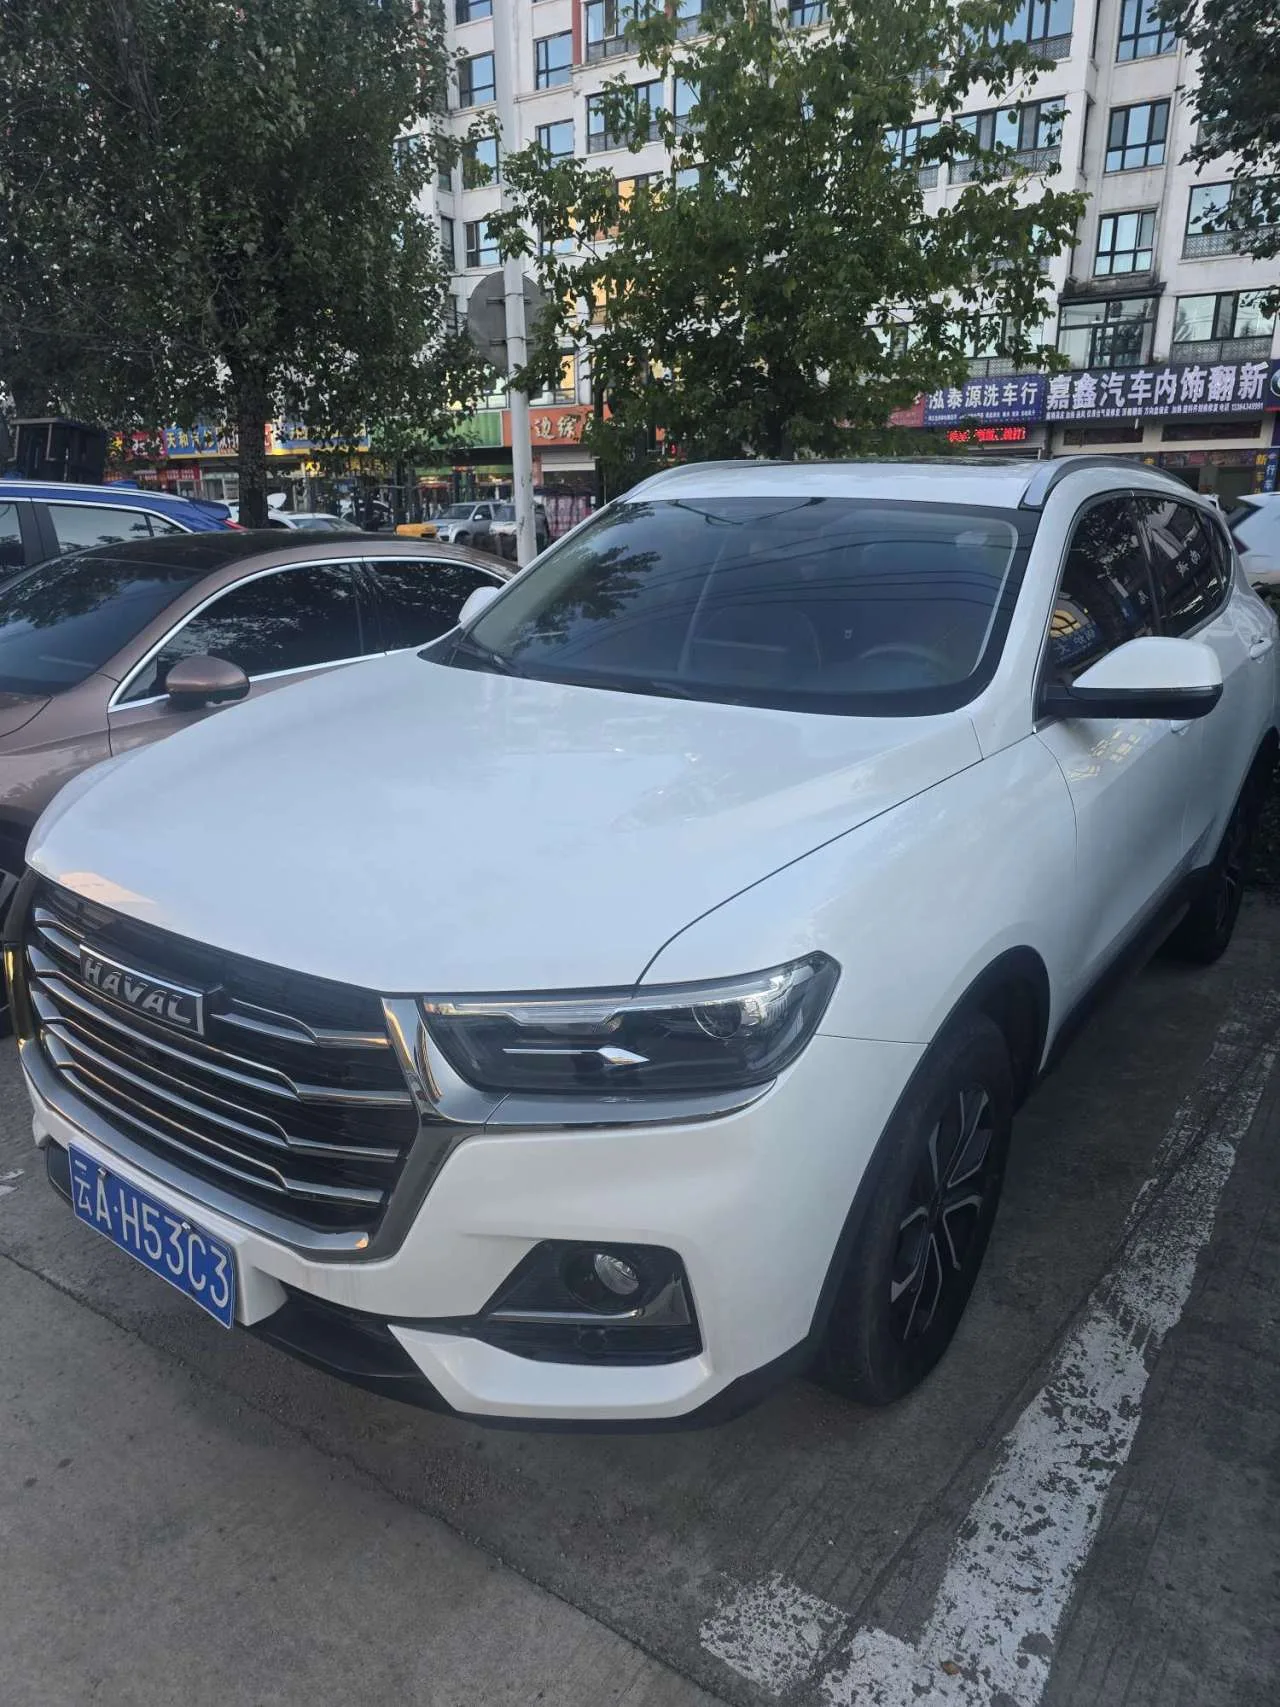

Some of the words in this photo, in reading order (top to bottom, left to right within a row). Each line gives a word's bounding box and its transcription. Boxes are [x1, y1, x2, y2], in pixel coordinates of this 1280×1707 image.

[928, 382, 1038, 409] 泓泰源洗车行
[1046, 361, 1269, 410] 嘉鑫汽车内饰翻新
[84, 957, 192, 1024] HAVAL
